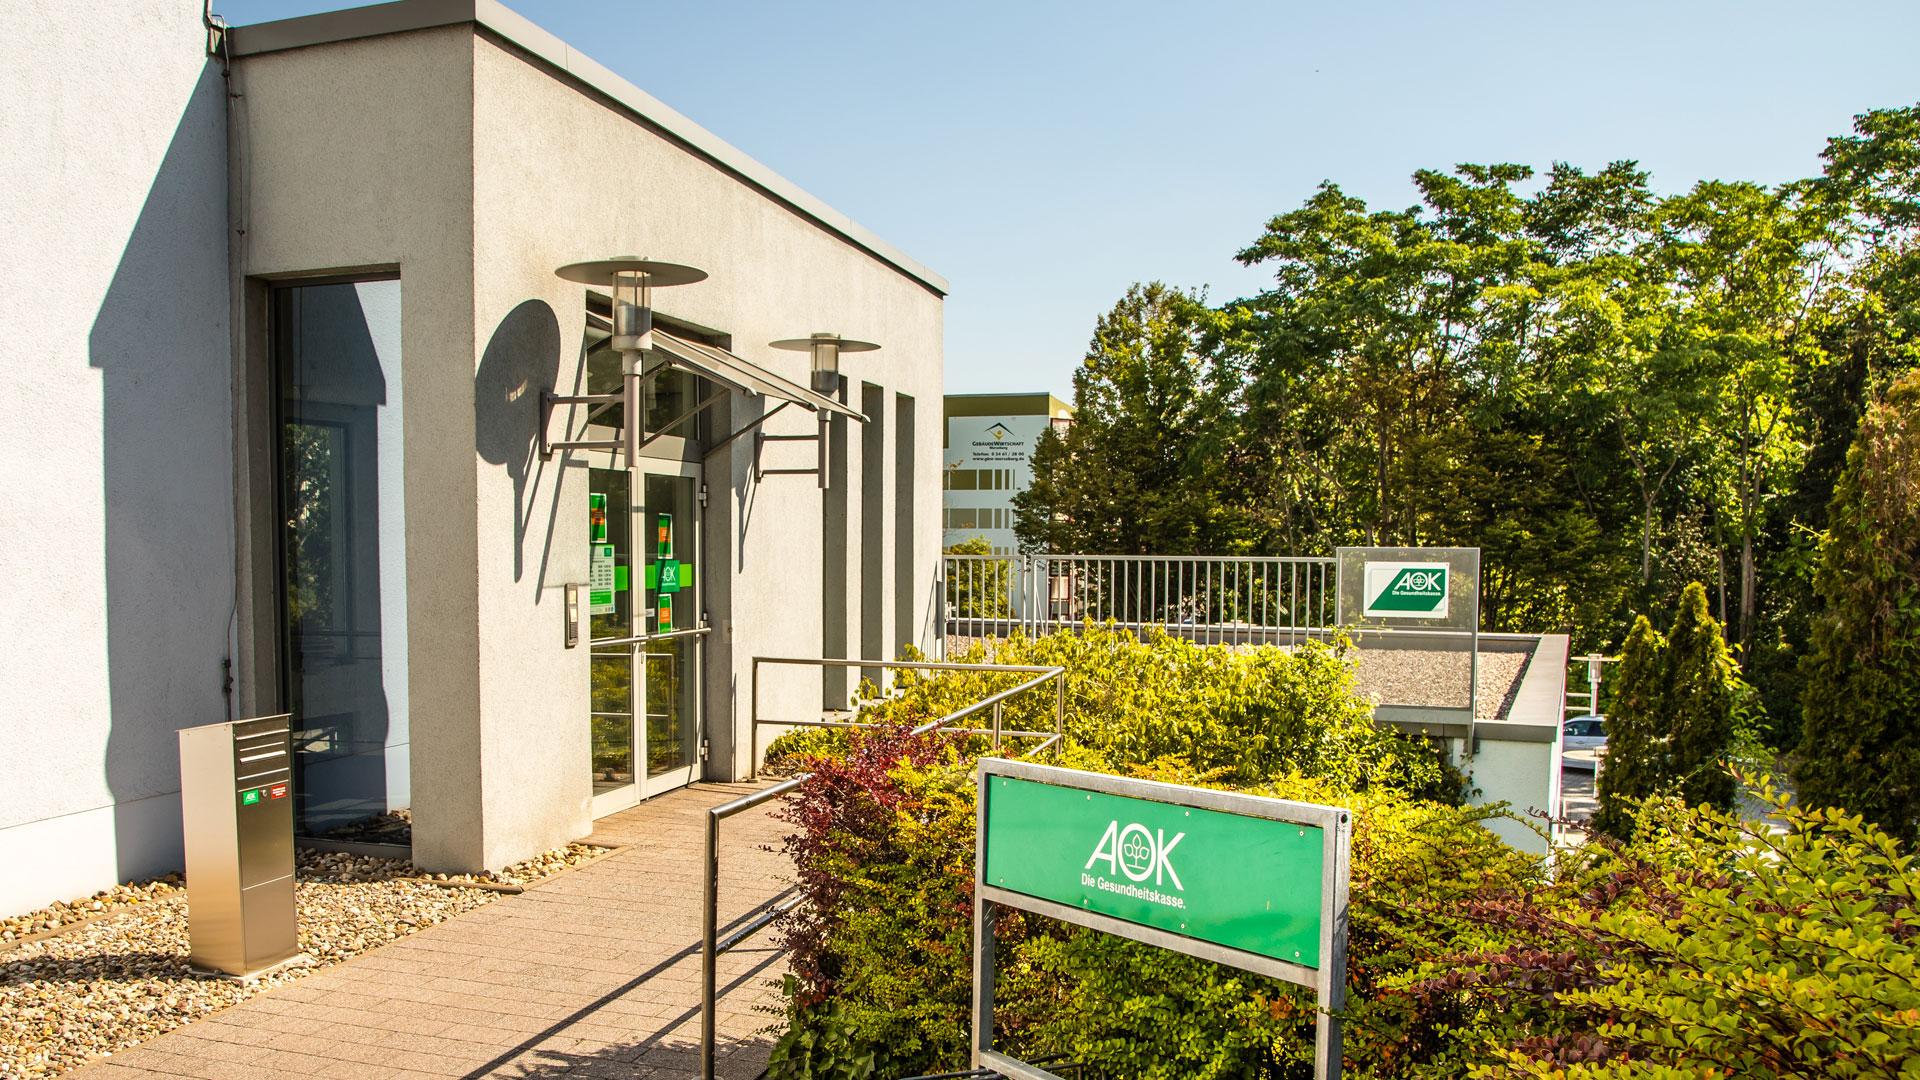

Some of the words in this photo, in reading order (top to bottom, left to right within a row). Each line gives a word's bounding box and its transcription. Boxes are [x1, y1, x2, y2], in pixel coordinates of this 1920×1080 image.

[1394, 572, 1442, 591] AOK
[1084, 820, 1186, 891] AOK
[1081, 873, 1095, 888] Die
[1097, 877, 1186, 909] Gesundheitskasse.
